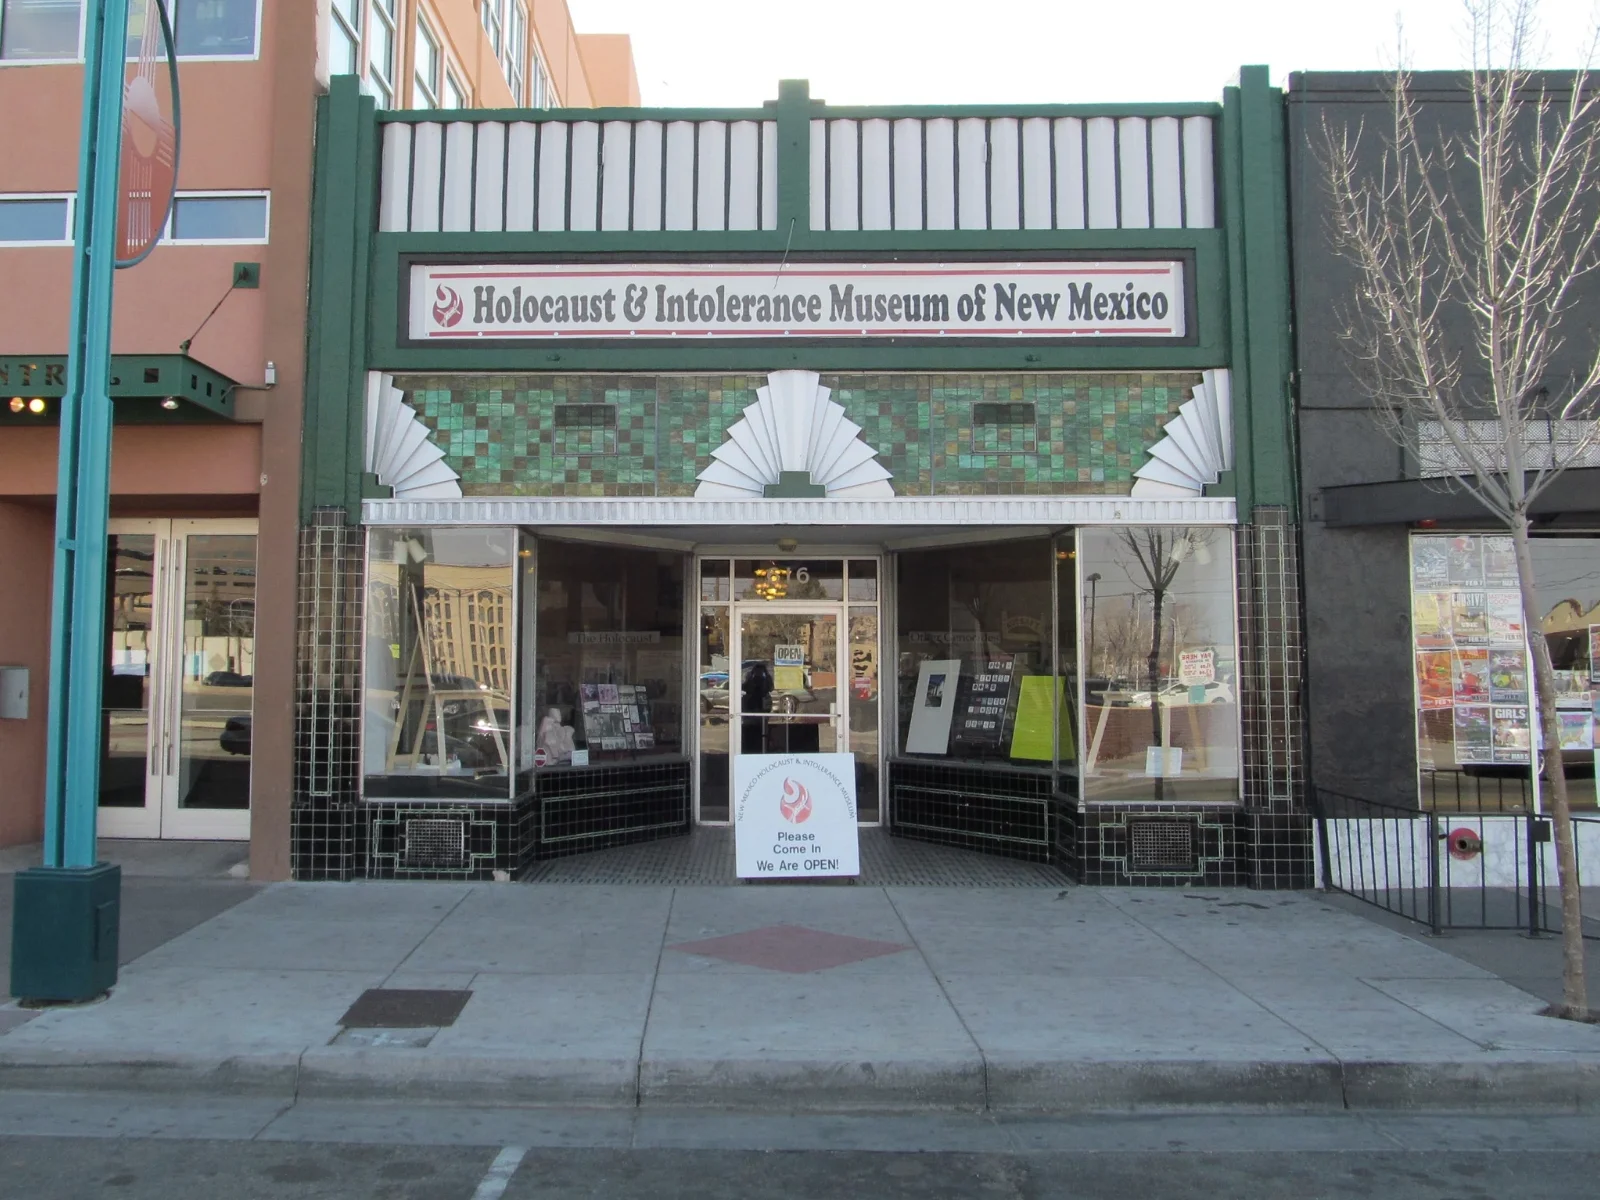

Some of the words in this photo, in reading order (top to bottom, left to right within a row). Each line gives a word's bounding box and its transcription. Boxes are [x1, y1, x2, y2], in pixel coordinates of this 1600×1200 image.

[473, 285, 616, 323] Holocaust
[623, 283, 648, 322] &
[655, 284, 821, 322] Intolerance
[829, 284, 950, 322] Museum
[957, 284, 986, 322] of
[994, 282, 1060, 322] New
[1068, 282, 1168, 321] Mexico
[577, 633, 597, 643] The
[600, 632, 652, 643] Holocaust
[778, 647, 801, 660] OPEN
[1495, 708, 1526, 719] GIRLS
[737, 804, 745, 821] NEW
[741, 777, 758, 803] MEXICO
[756, 758, 794, 780] HOLOCAUST
[802, 759, 842, 787] INTOLERANCE
[840, 787, 855, 819] MUSEUM
[777, 832, 815, 842] Please
[773, 844, 806, 854] Come
[811, 844, 821, 853] In
[757, 860, 774, 871] We
[779, 860, 799, 871] Are
[804, 859, 839, 870] OPEN!
